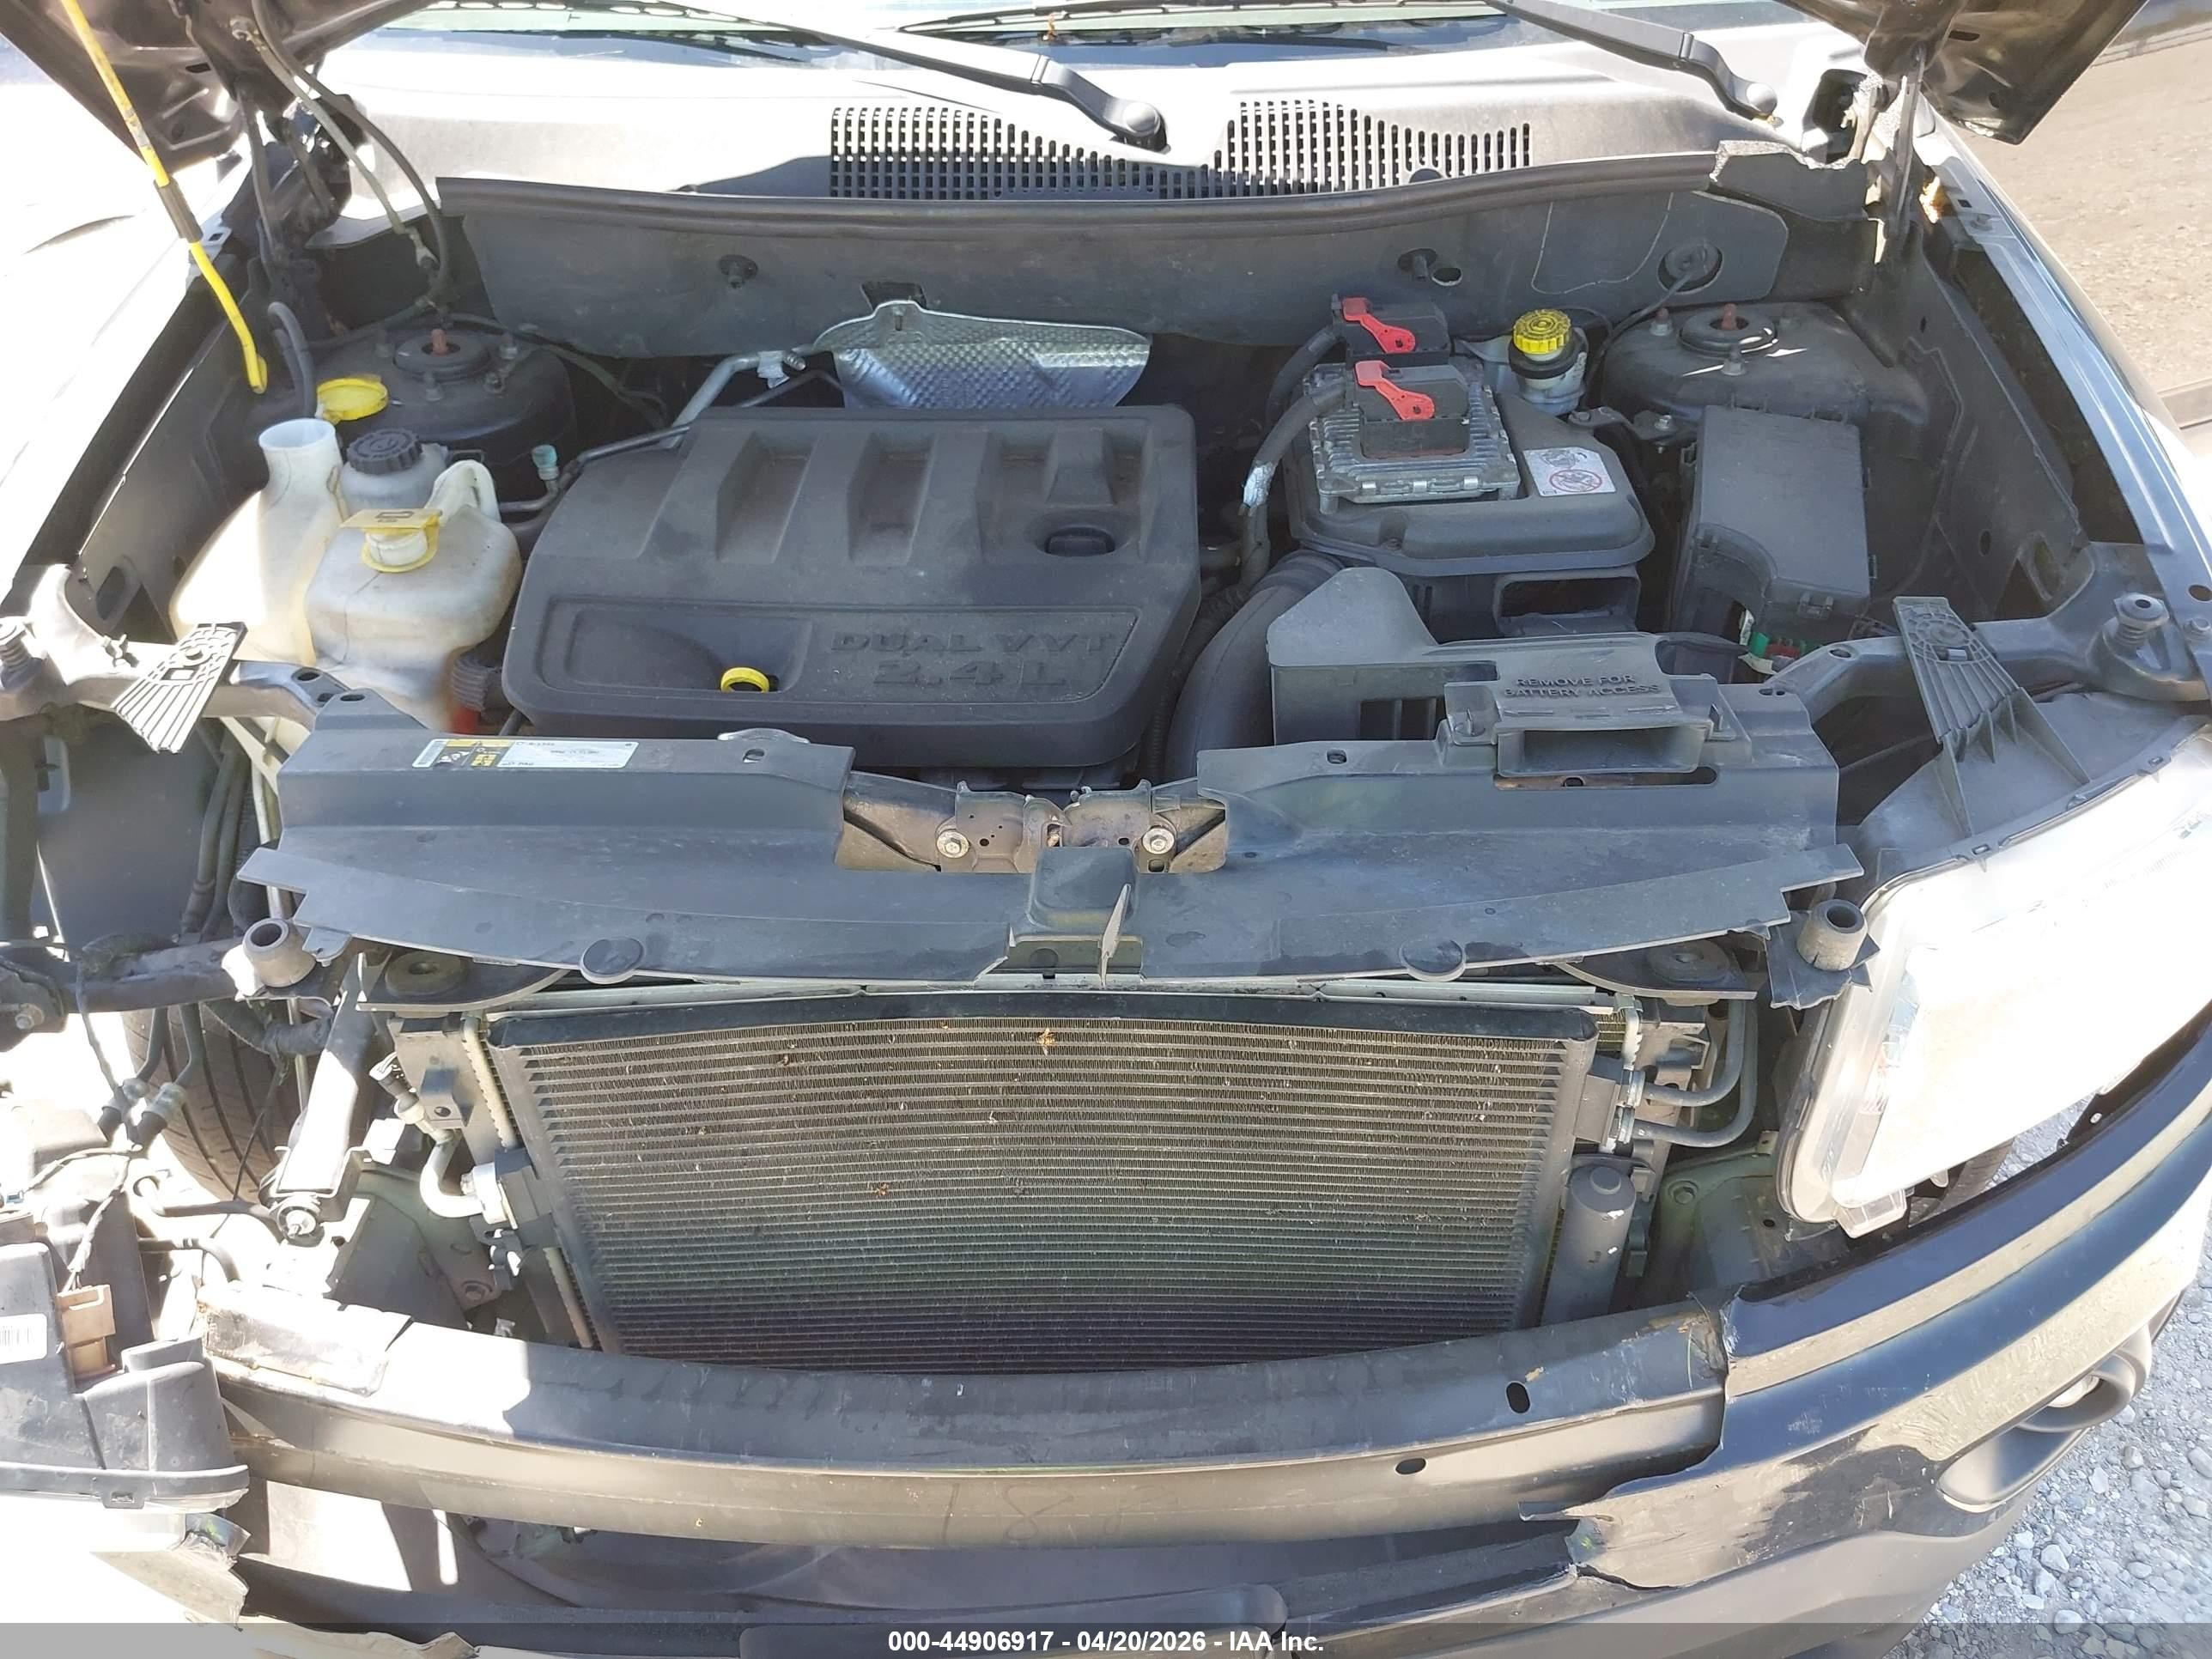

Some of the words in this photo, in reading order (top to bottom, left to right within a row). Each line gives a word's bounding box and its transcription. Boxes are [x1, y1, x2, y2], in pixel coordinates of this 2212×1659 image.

[830, 631, 982, 652] DUAL
[996, 631, 1115, 652] VVT
[872, 659, 1067, 687] 2.4L
[1516, 677, 1594, 687] REMOVE
[1598, 674, 1636, 685] FOR
[1504, 688, 1580, 698] BATTERY
[1589, 684, 1662, 696] ACCESS
